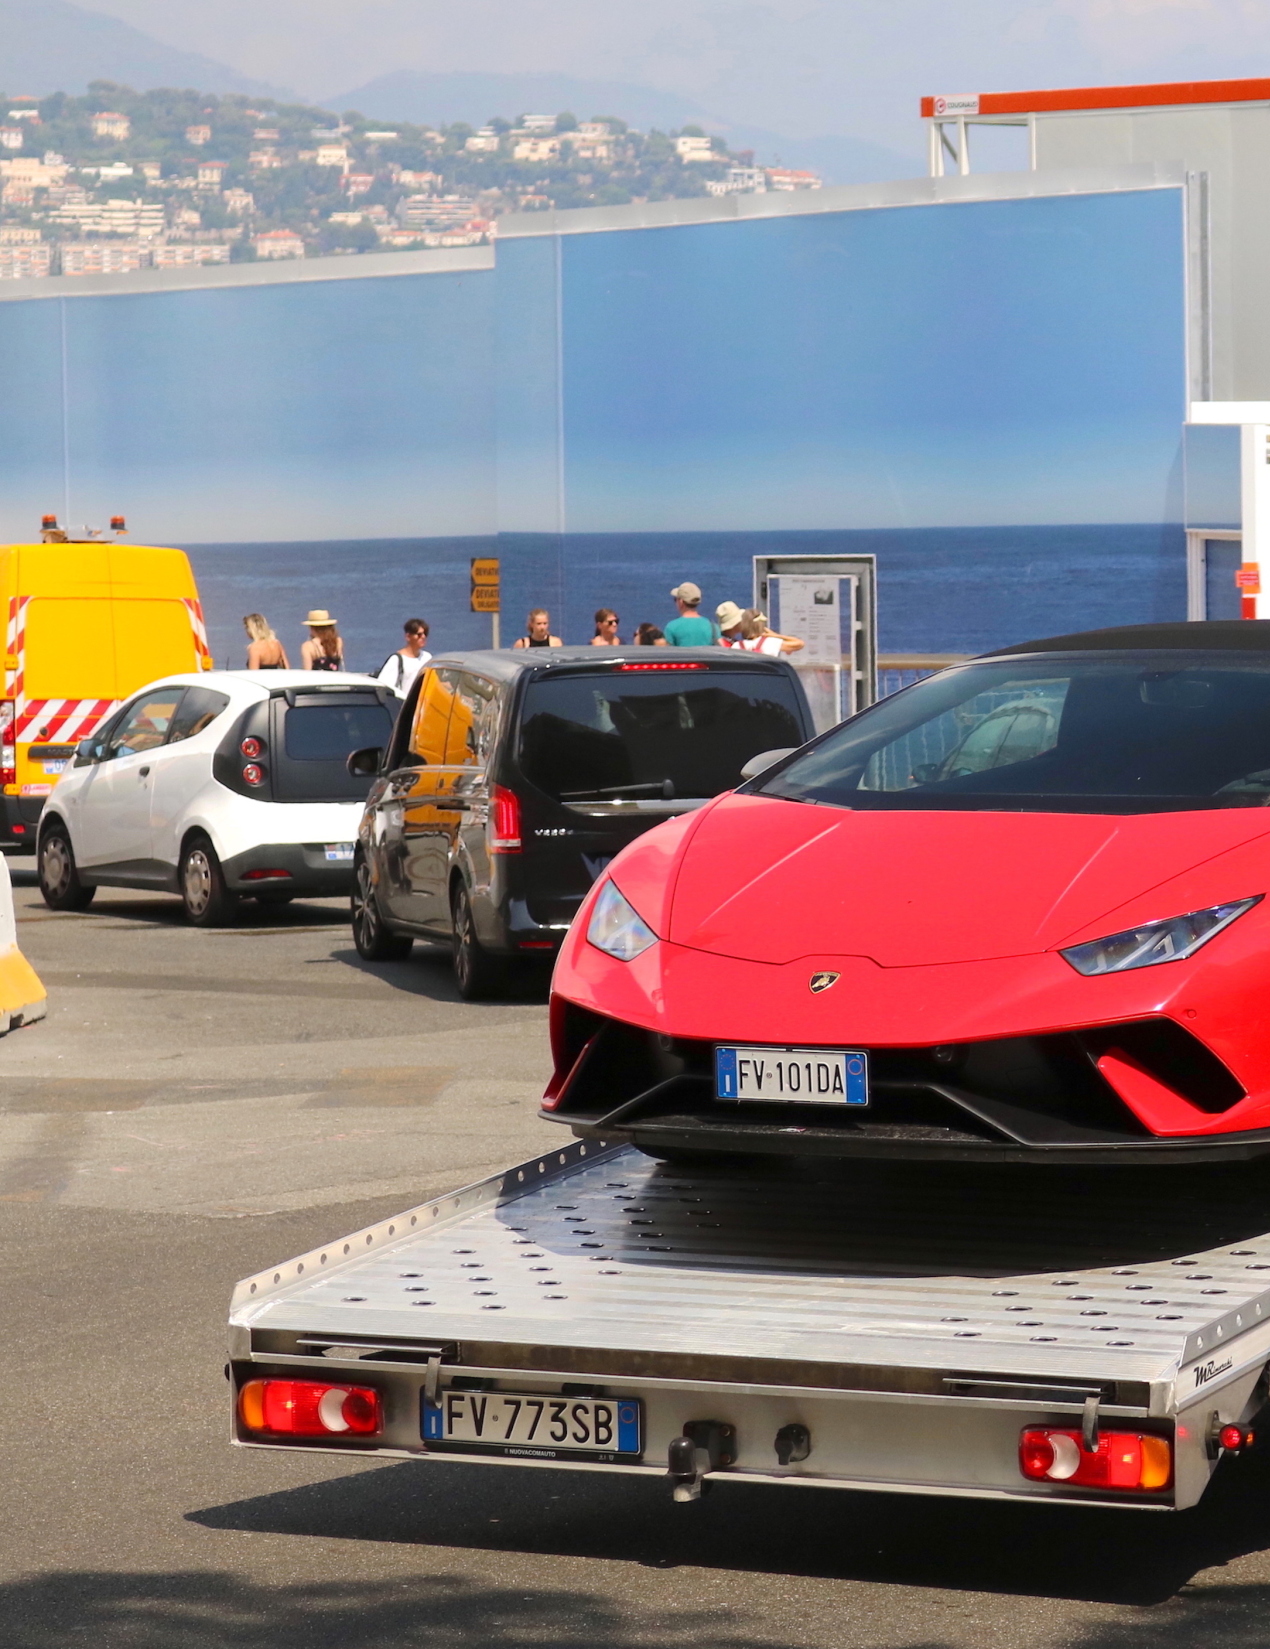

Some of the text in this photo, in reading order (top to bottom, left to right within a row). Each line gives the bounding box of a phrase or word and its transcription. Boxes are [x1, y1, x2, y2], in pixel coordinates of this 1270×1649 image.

[738, 1059, 765, 1090] FV
[776, 1061, 844, 1094] 101DA
[447, 1394, 488, 1437] FV
[503, 1400, 614, 1445] 773SB
[509, 1448, 556, 1458] NUOVACOMAUTO
